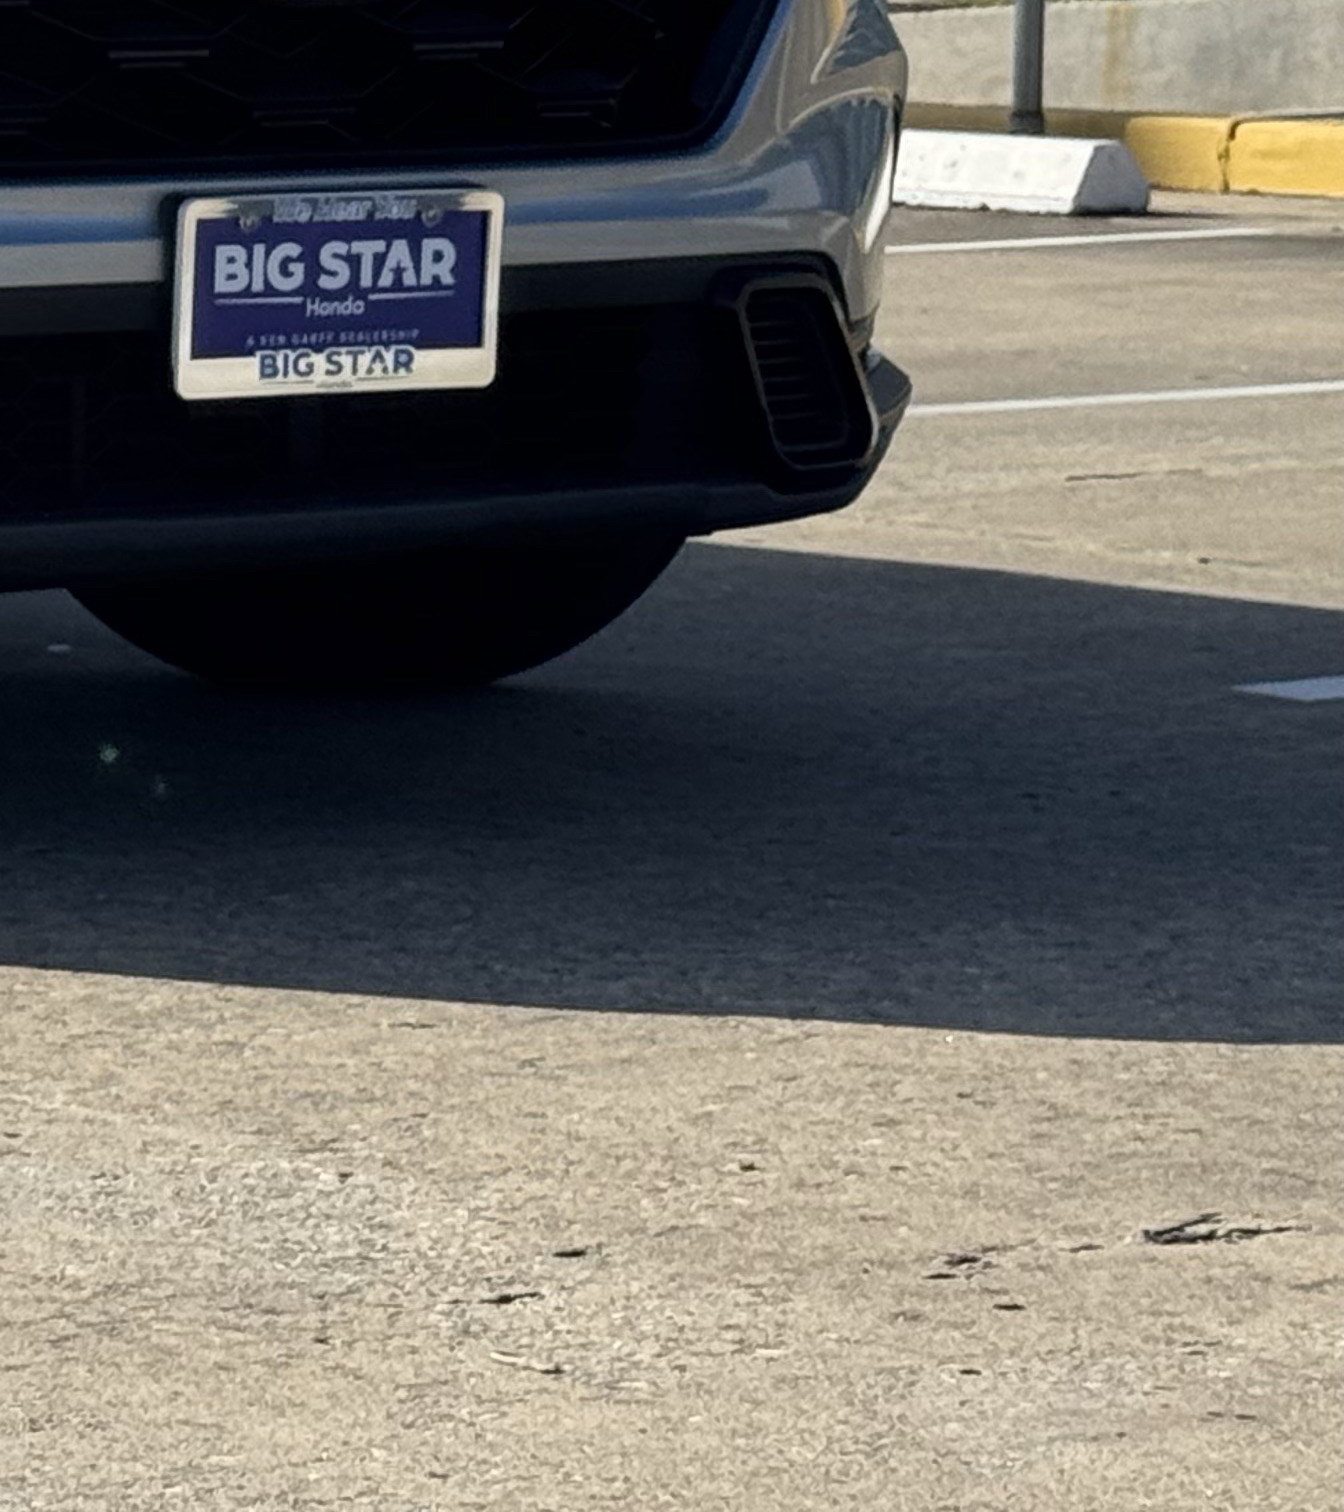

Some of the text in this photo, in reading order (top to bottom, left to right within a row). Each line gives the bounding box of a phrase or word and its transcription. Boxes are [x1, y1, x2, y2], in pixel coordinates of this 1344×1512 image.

[213, 237, 457, 294] BIG STAR
[305, 295, 366, 318] Honda
[259, 347, 415, 379] BIG STAR
